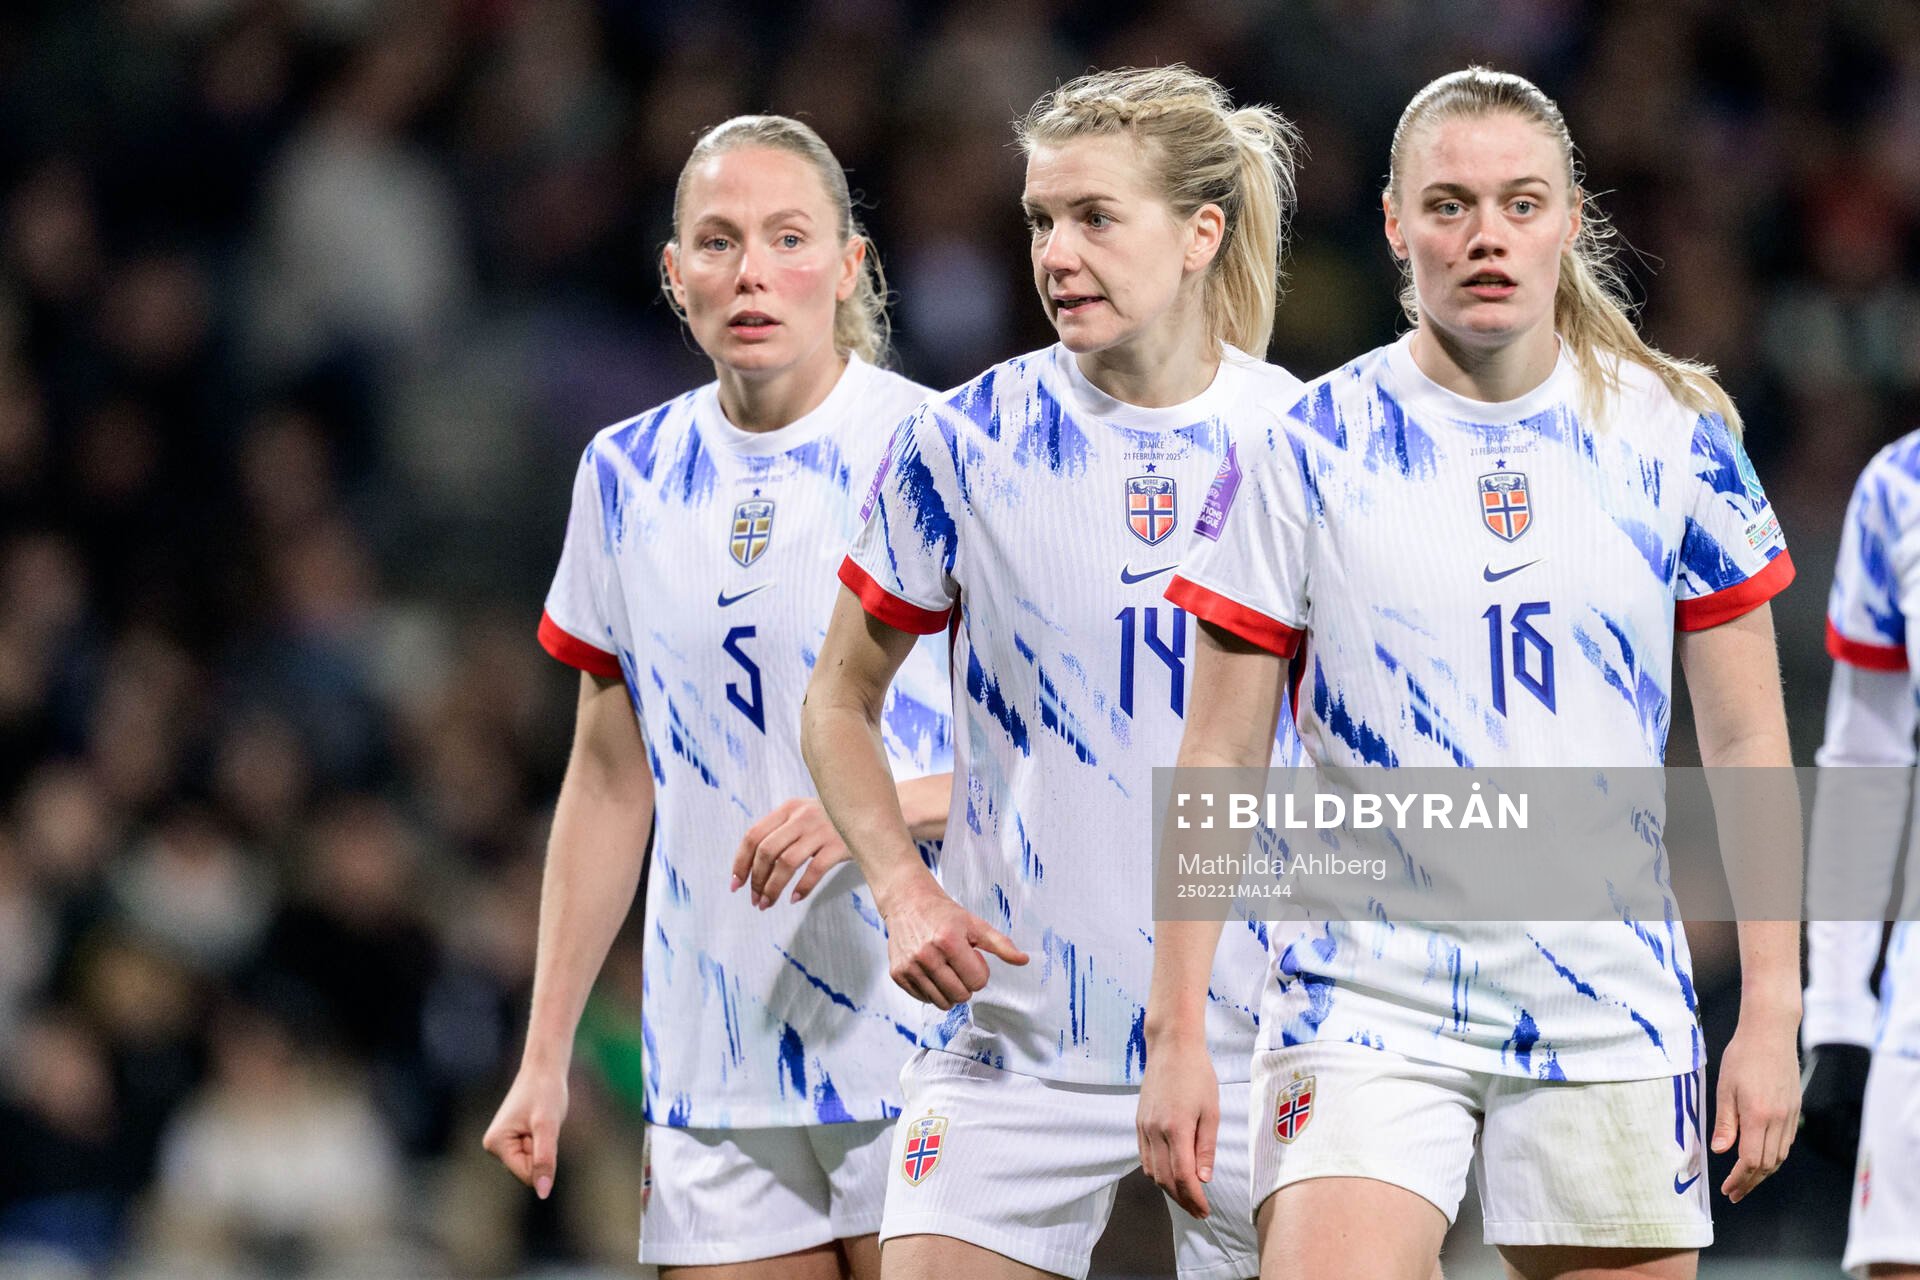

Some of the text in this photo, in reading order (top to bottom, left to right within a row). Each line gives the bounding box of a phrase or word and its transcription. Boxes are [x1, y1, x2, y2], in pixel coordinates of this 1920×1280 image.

[1123, 452, 1182, 461] 21 FEBRUARY 2025
[722, 625, 766, 735] 5
[1114, 606, 1187, 720] 14
[1482, 601, 1556, 718] 16
